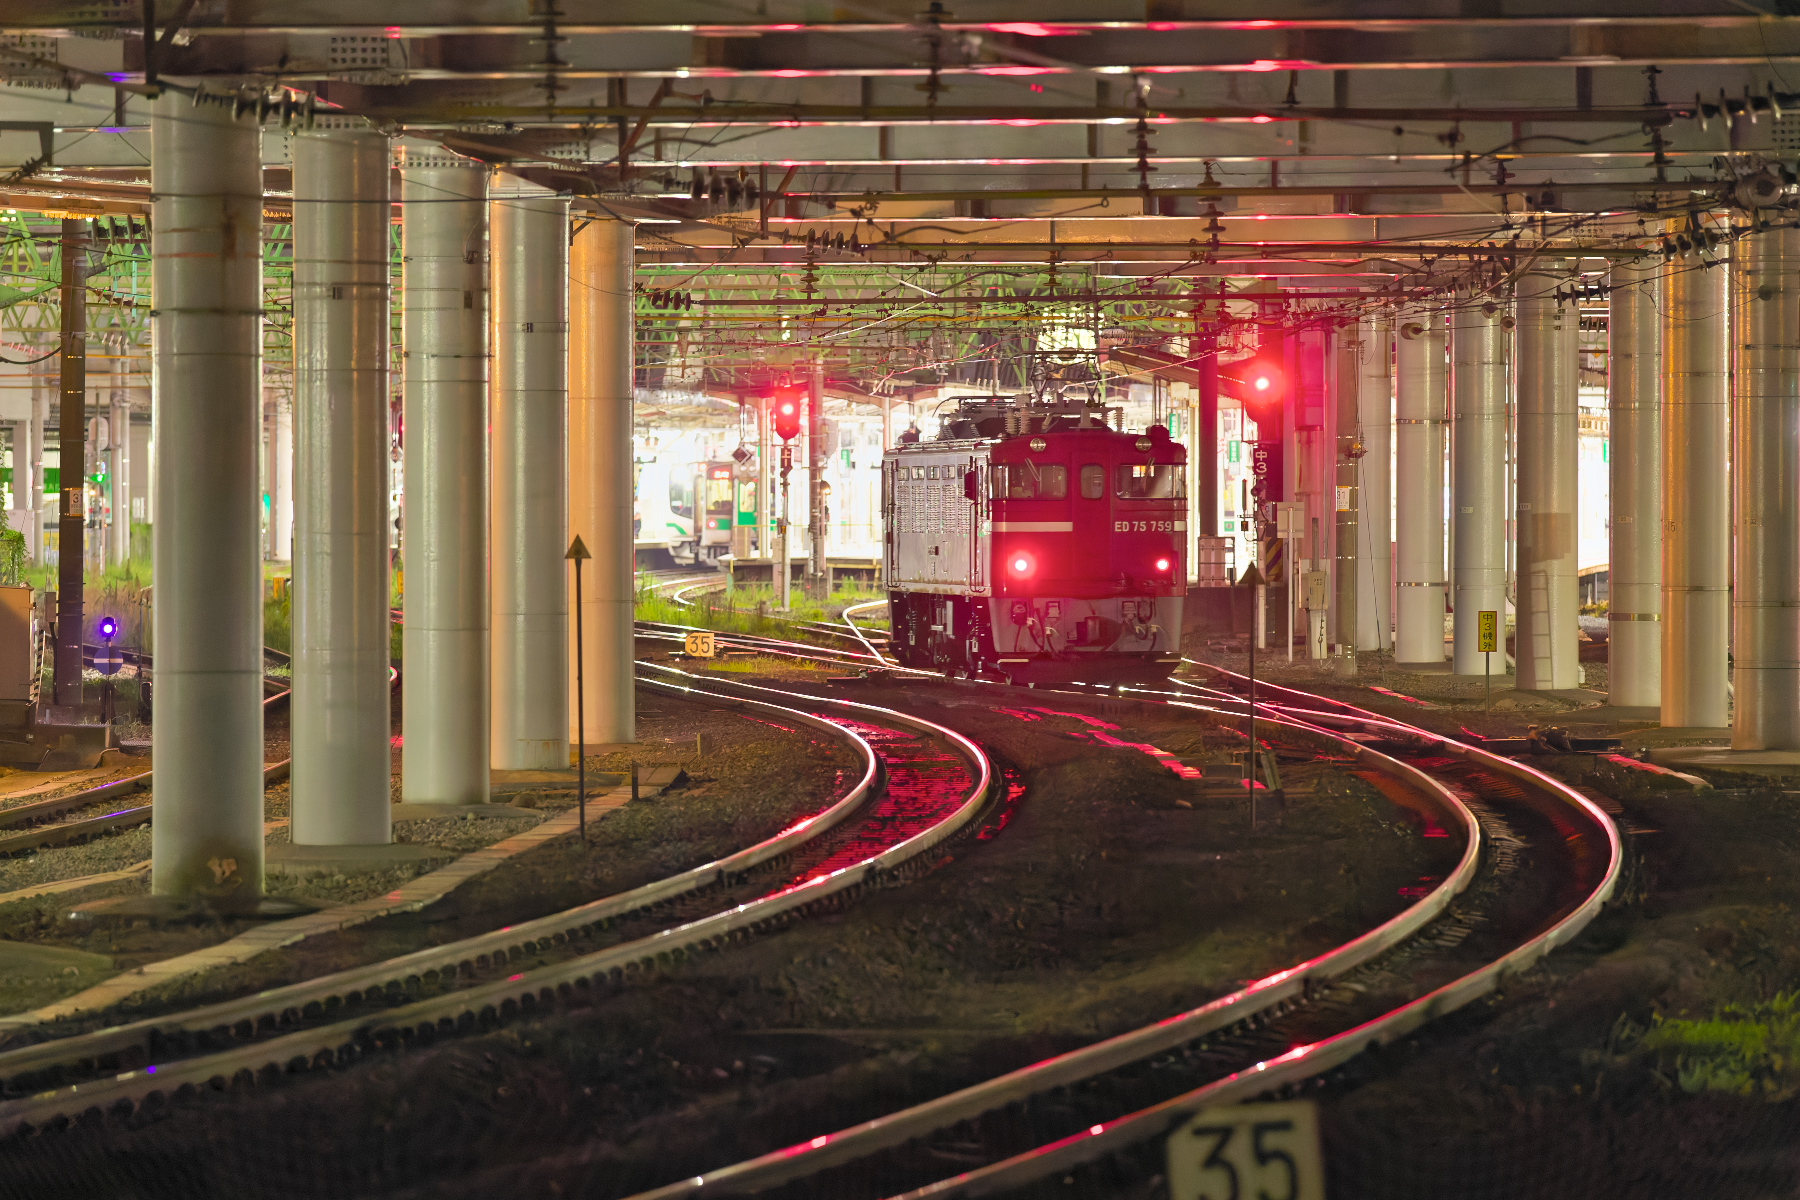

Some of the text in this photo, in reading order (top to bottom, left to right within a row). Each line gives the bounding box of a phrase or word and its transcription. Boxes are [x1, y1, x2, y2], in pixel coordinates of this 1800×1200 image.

[1255, 449, 1268, 474] 中3
[1114, 520, 1172, 532] ED 75 759
[689, 635, 711, 654] 35
[1190, 1119, 1300, 1200] 35
